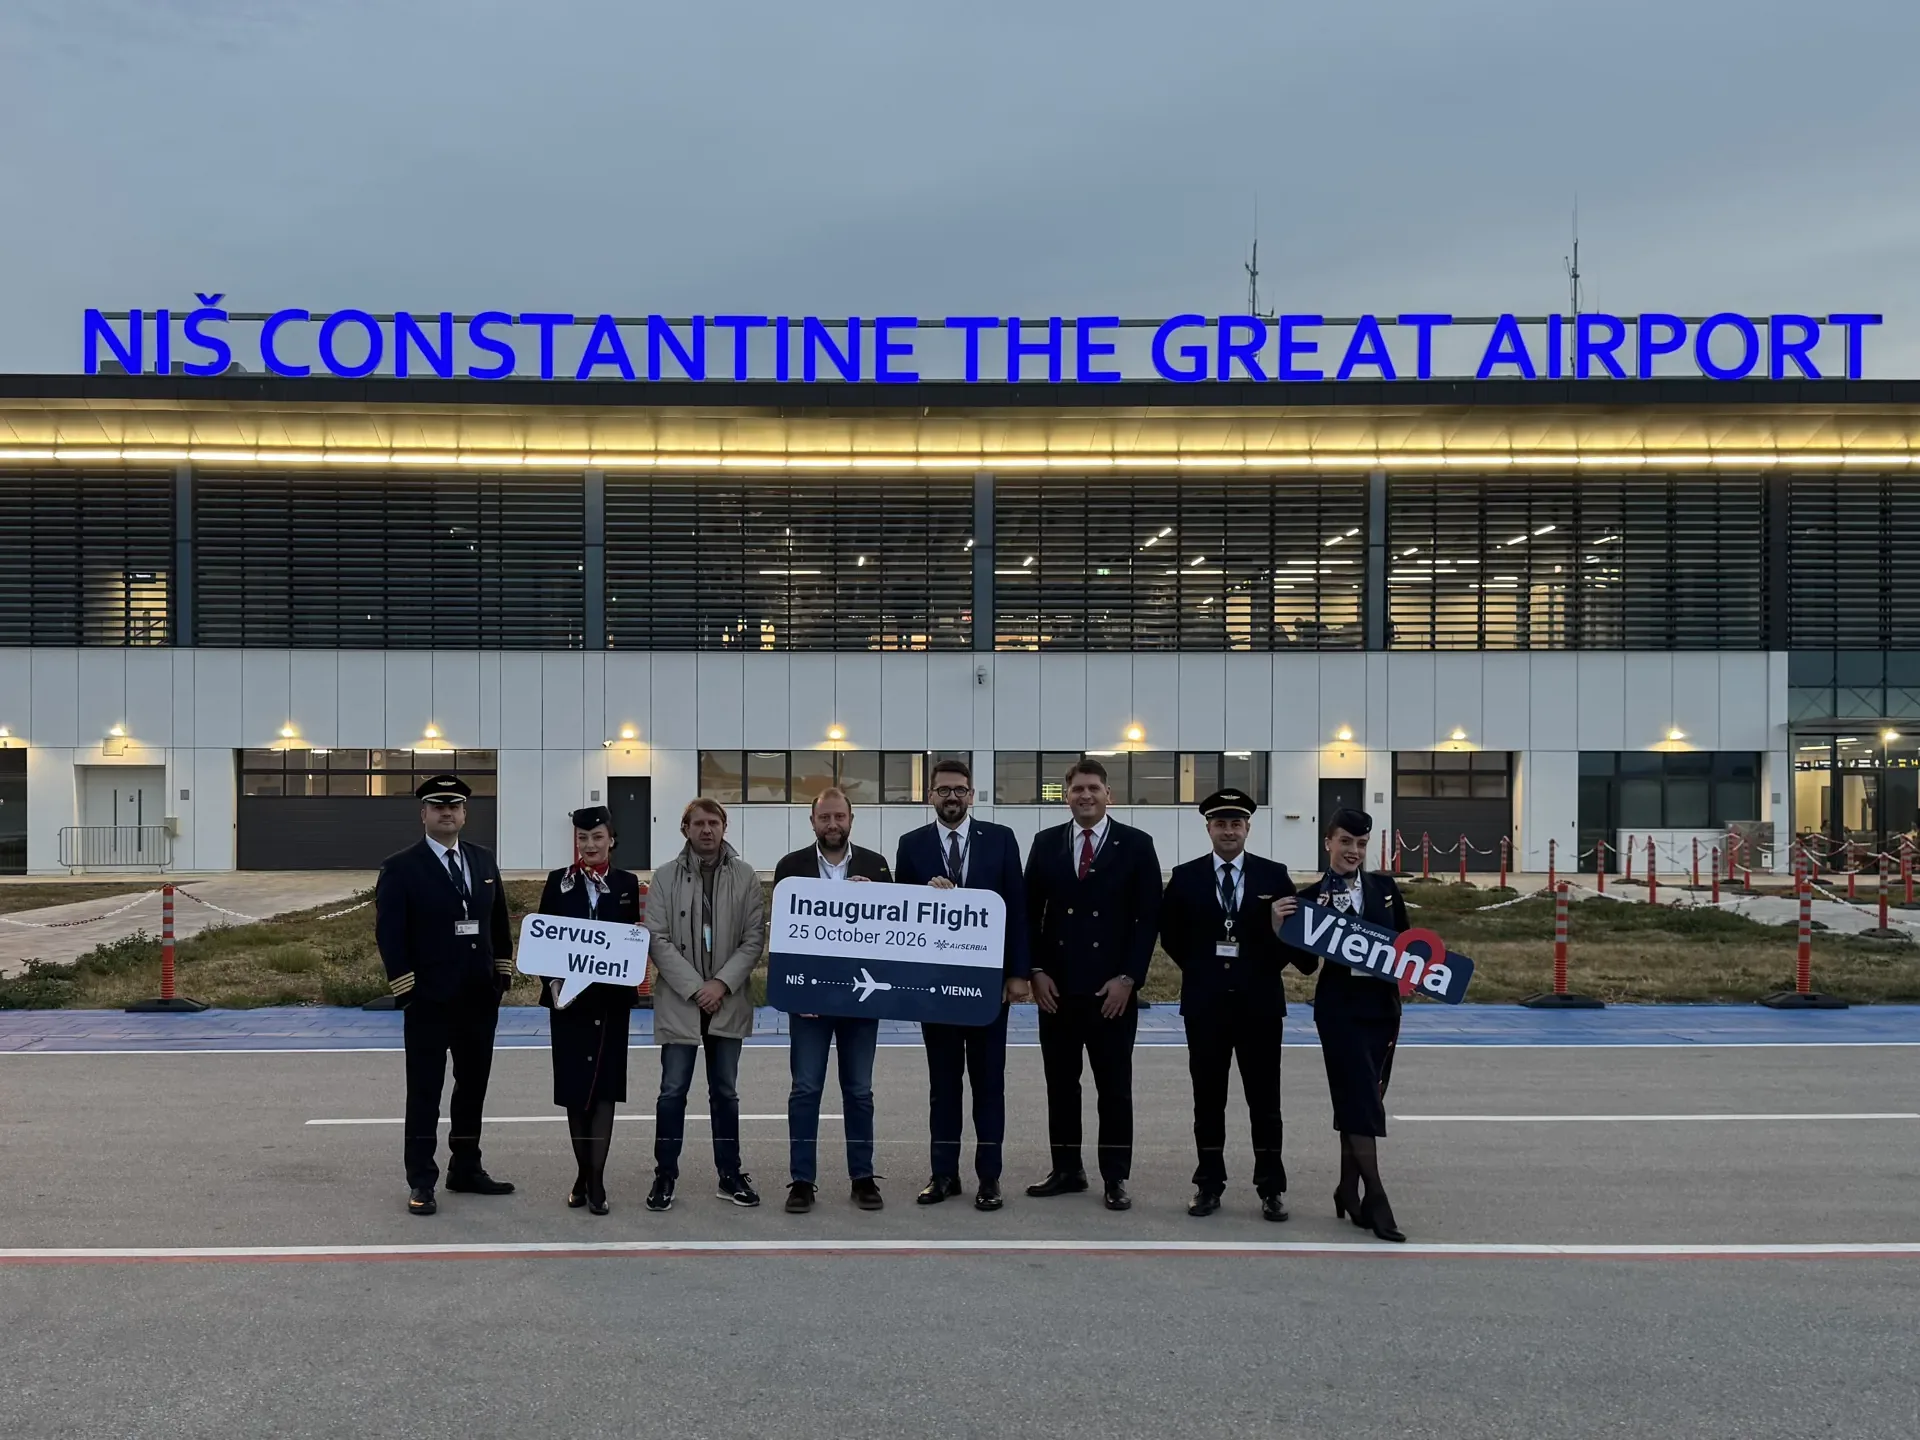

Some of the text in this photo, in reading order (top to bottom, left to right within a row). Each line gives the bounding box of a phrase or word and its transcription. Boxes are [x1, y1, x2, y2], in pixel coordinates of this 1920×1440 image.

[84, 293, 1882, 384] NIŠ CONSTANTINE THE GREAT AIRPORT
[789, 893, 989, 929] Inaugural Flight
[530, 919, 612, 950] Servus,
[788, 923, 927, 949] 25 October 2026
[1303, 906, 1452, 995] Vienna
[567, 953, 629, 978] Wien!
[785, 974, 805, 985] NIŠ
[941, 985, 983, 998] VIENNA
